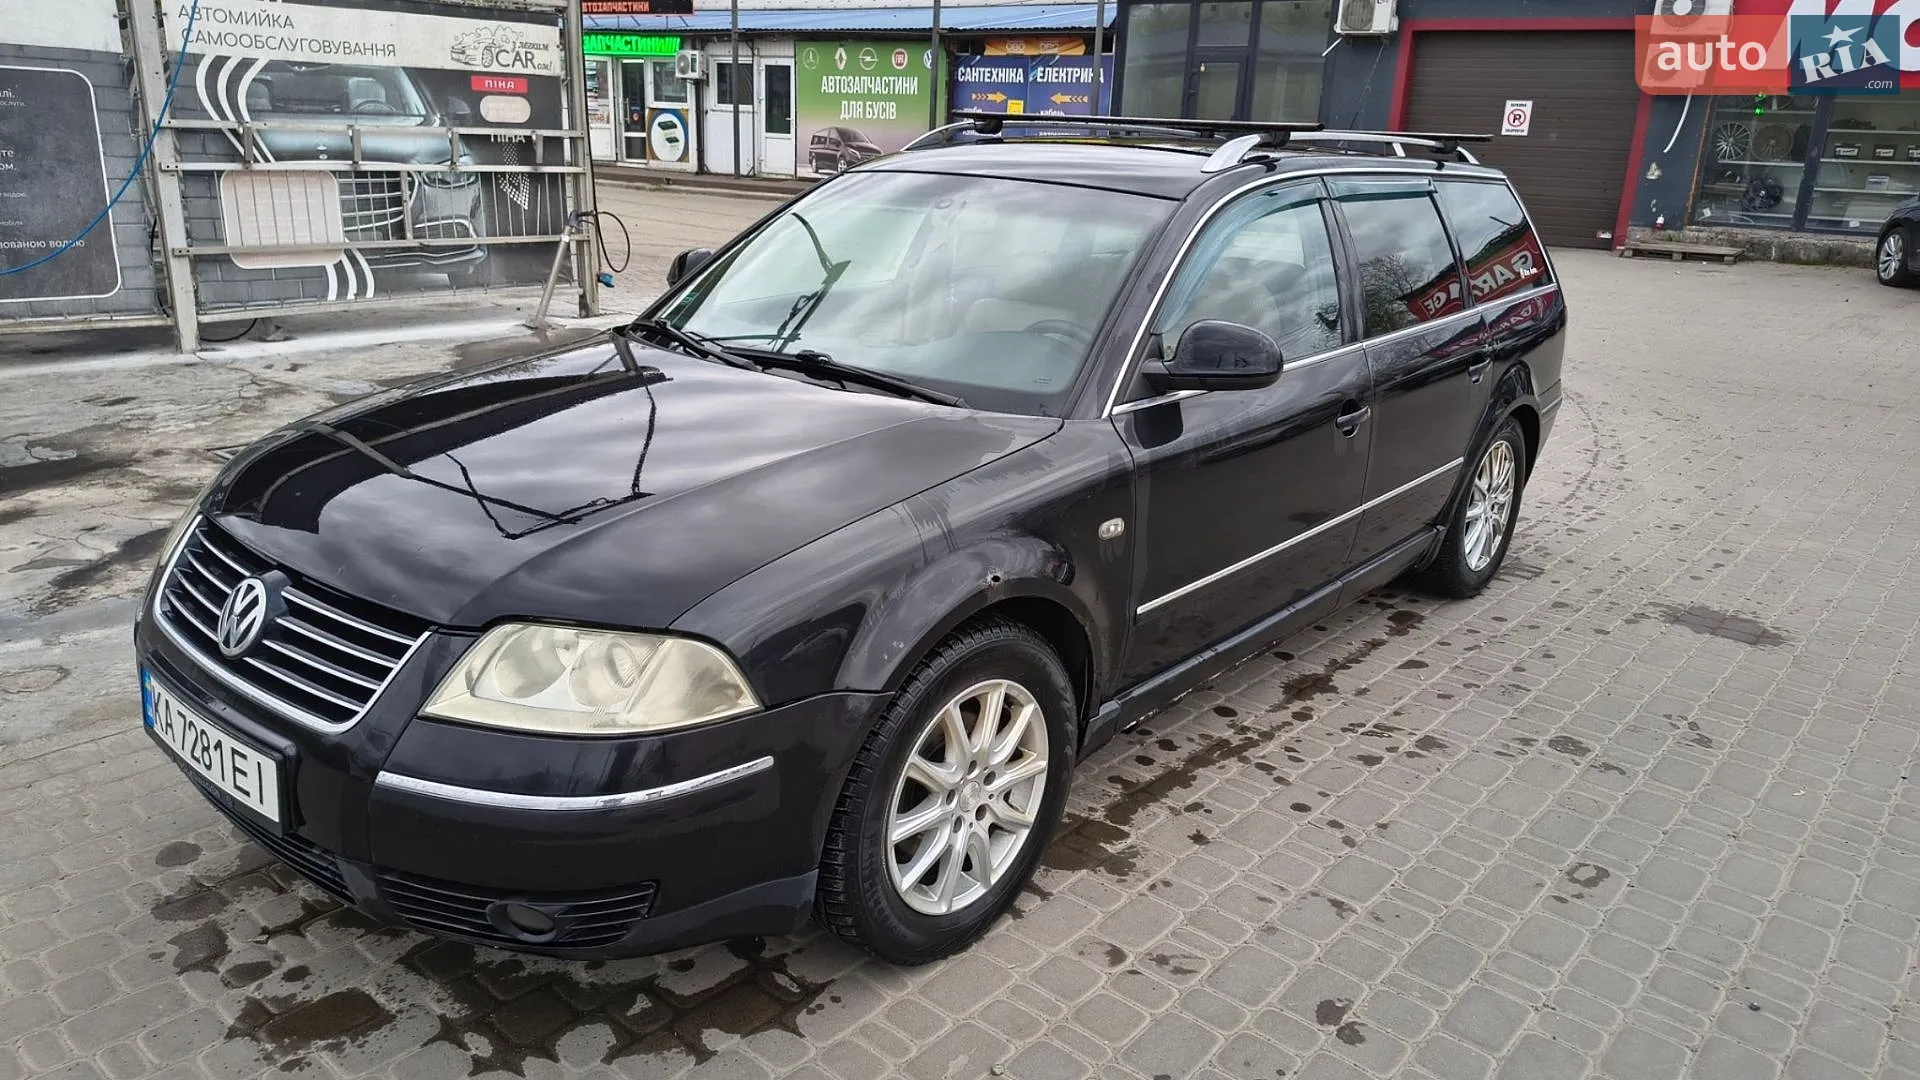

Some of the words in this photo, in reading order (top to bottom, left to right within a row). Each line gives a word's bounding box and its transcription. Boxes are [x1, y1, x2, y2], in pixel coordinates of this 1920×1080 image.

[178, 4, 295, 29] АВТОМИЙКА
[181, 27, 396, 57] САМООБСЛУГОВУВАННЯ
[958, 66, 1024, 83] САНТЕХНІКА
[485, 80, 515, 89] ПІНА
[821, 76, 918, 95] АВТОЗАПЧАСТИНИ
[840, 100, 863, 120] ДЛЯ
[866, 101, 897, 120] БУСІВ
